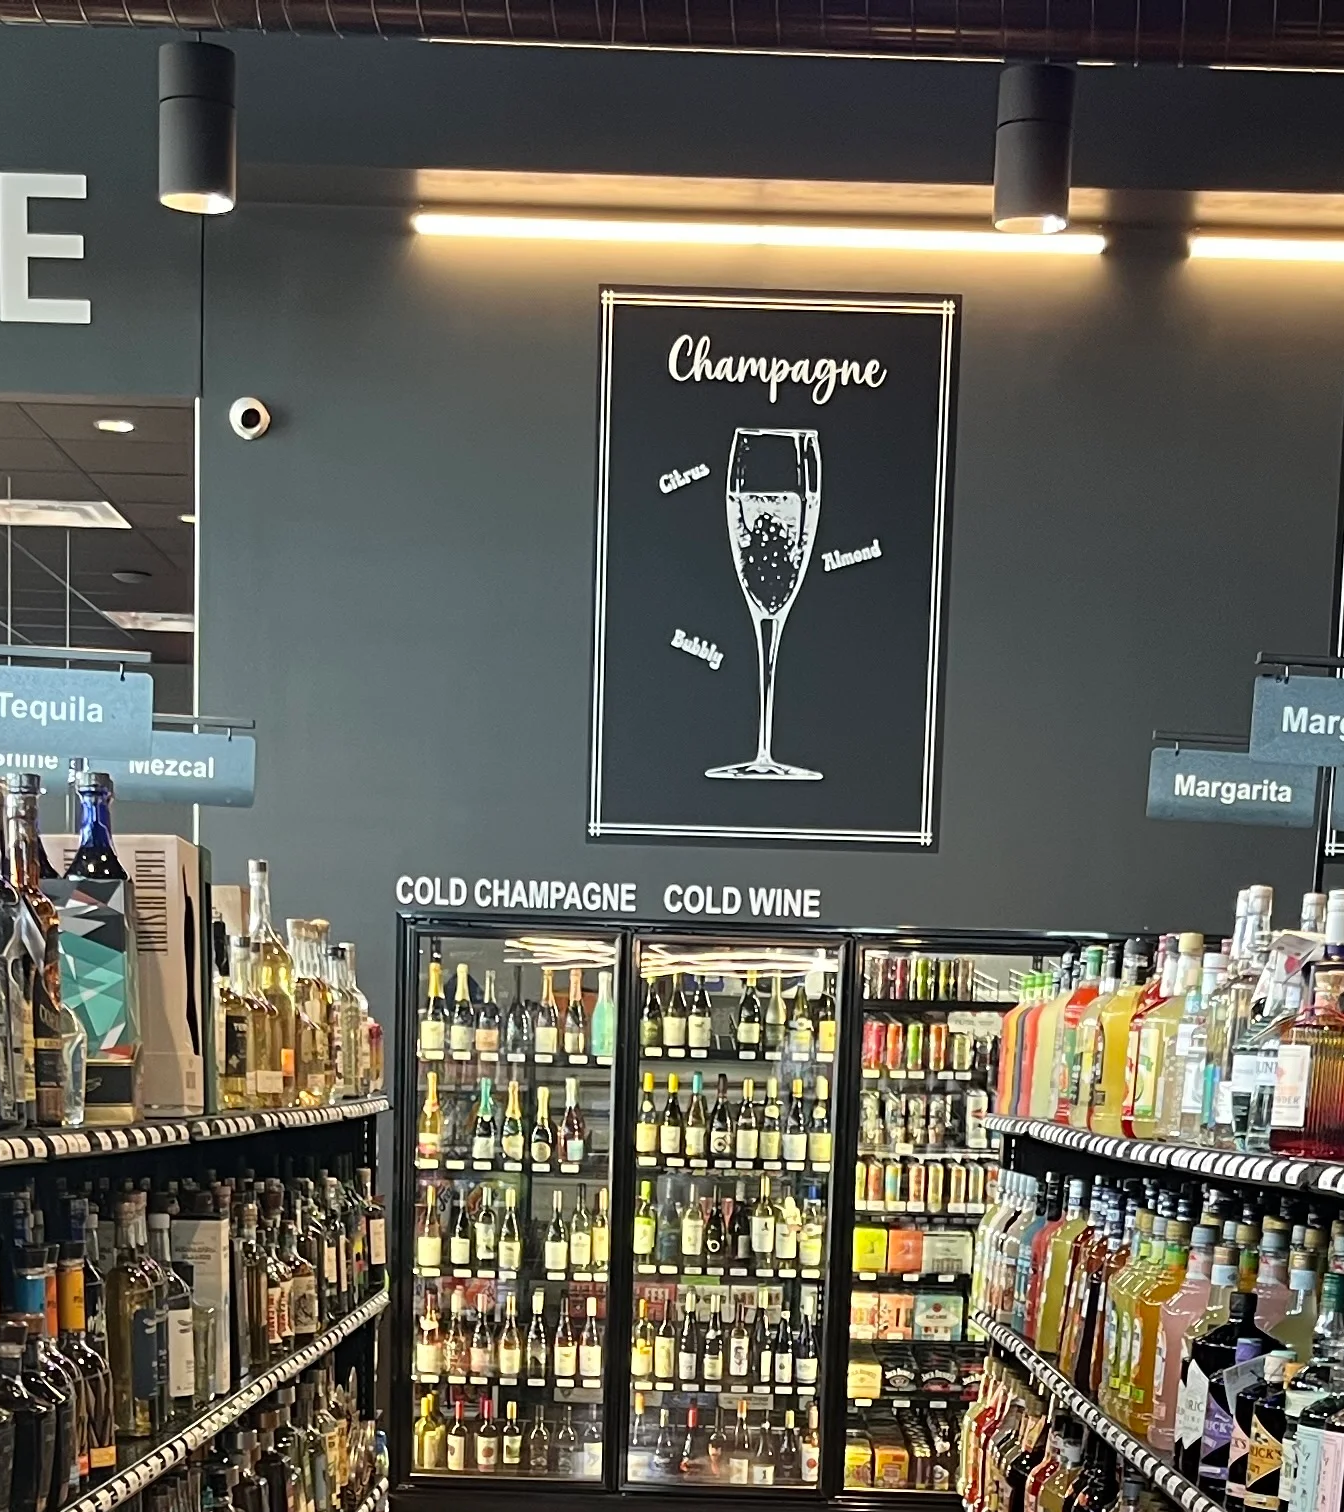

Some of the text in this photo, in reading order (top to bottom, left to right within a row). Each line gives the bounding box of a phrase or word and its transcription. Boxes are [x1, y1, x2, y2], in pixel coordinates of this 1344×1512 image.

[667, 334, 888, 405] Champagne
[659, 463, 710, 494] Citrus
[821, 539, 883, 572] Almond
[670, 628, 725, 671] Bubbly
[129, 756, 214, 778] Mezcal
[1173, 774, 1294, 805] Margarita
[394, 876, 637, 913] COLD CHAMPAGNE
[663, 884, 822, 919] COLD WINE
